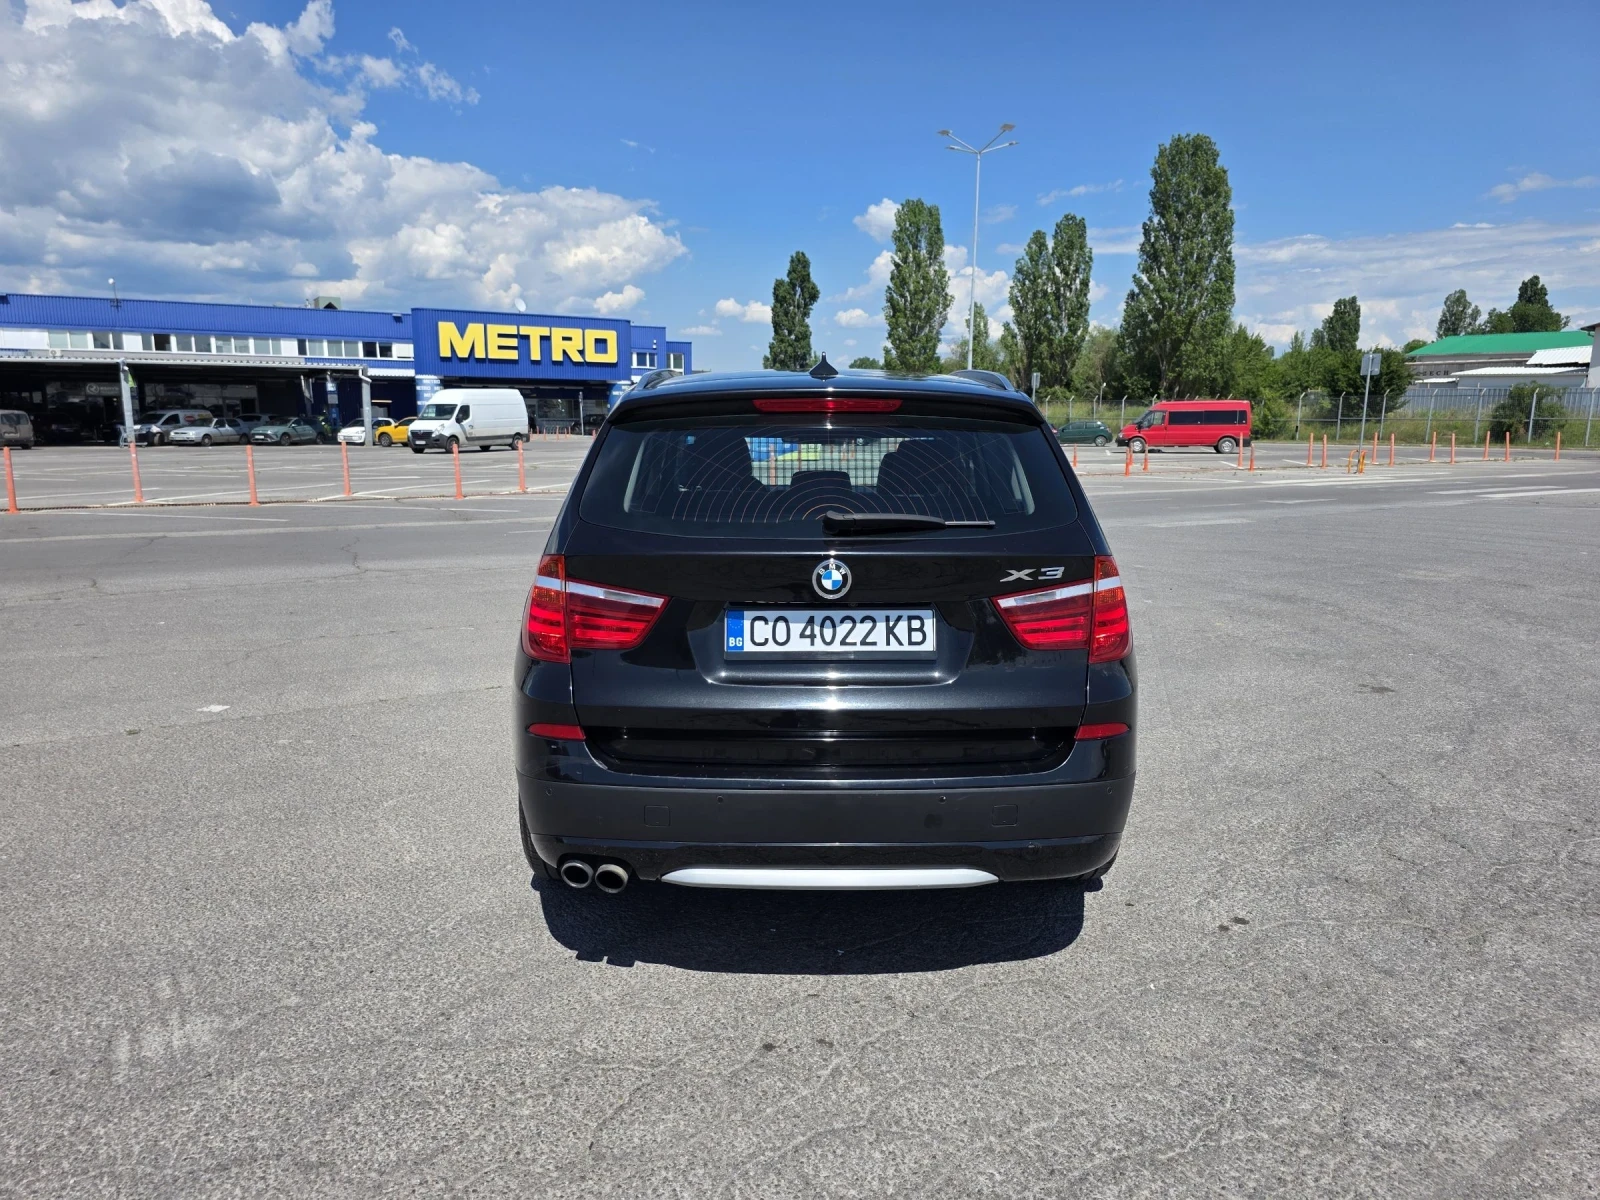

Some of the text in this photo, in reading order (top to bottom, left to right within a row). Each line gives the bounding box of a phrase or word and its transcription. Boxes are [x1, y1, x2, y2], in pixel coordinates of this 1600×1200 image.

[437, 321, 618, 364] METRO
[999, 566, 1065, 582] X3
[728, 637, 743, 647] BG
[749, 615, 927, 647] CO 4022 KB
